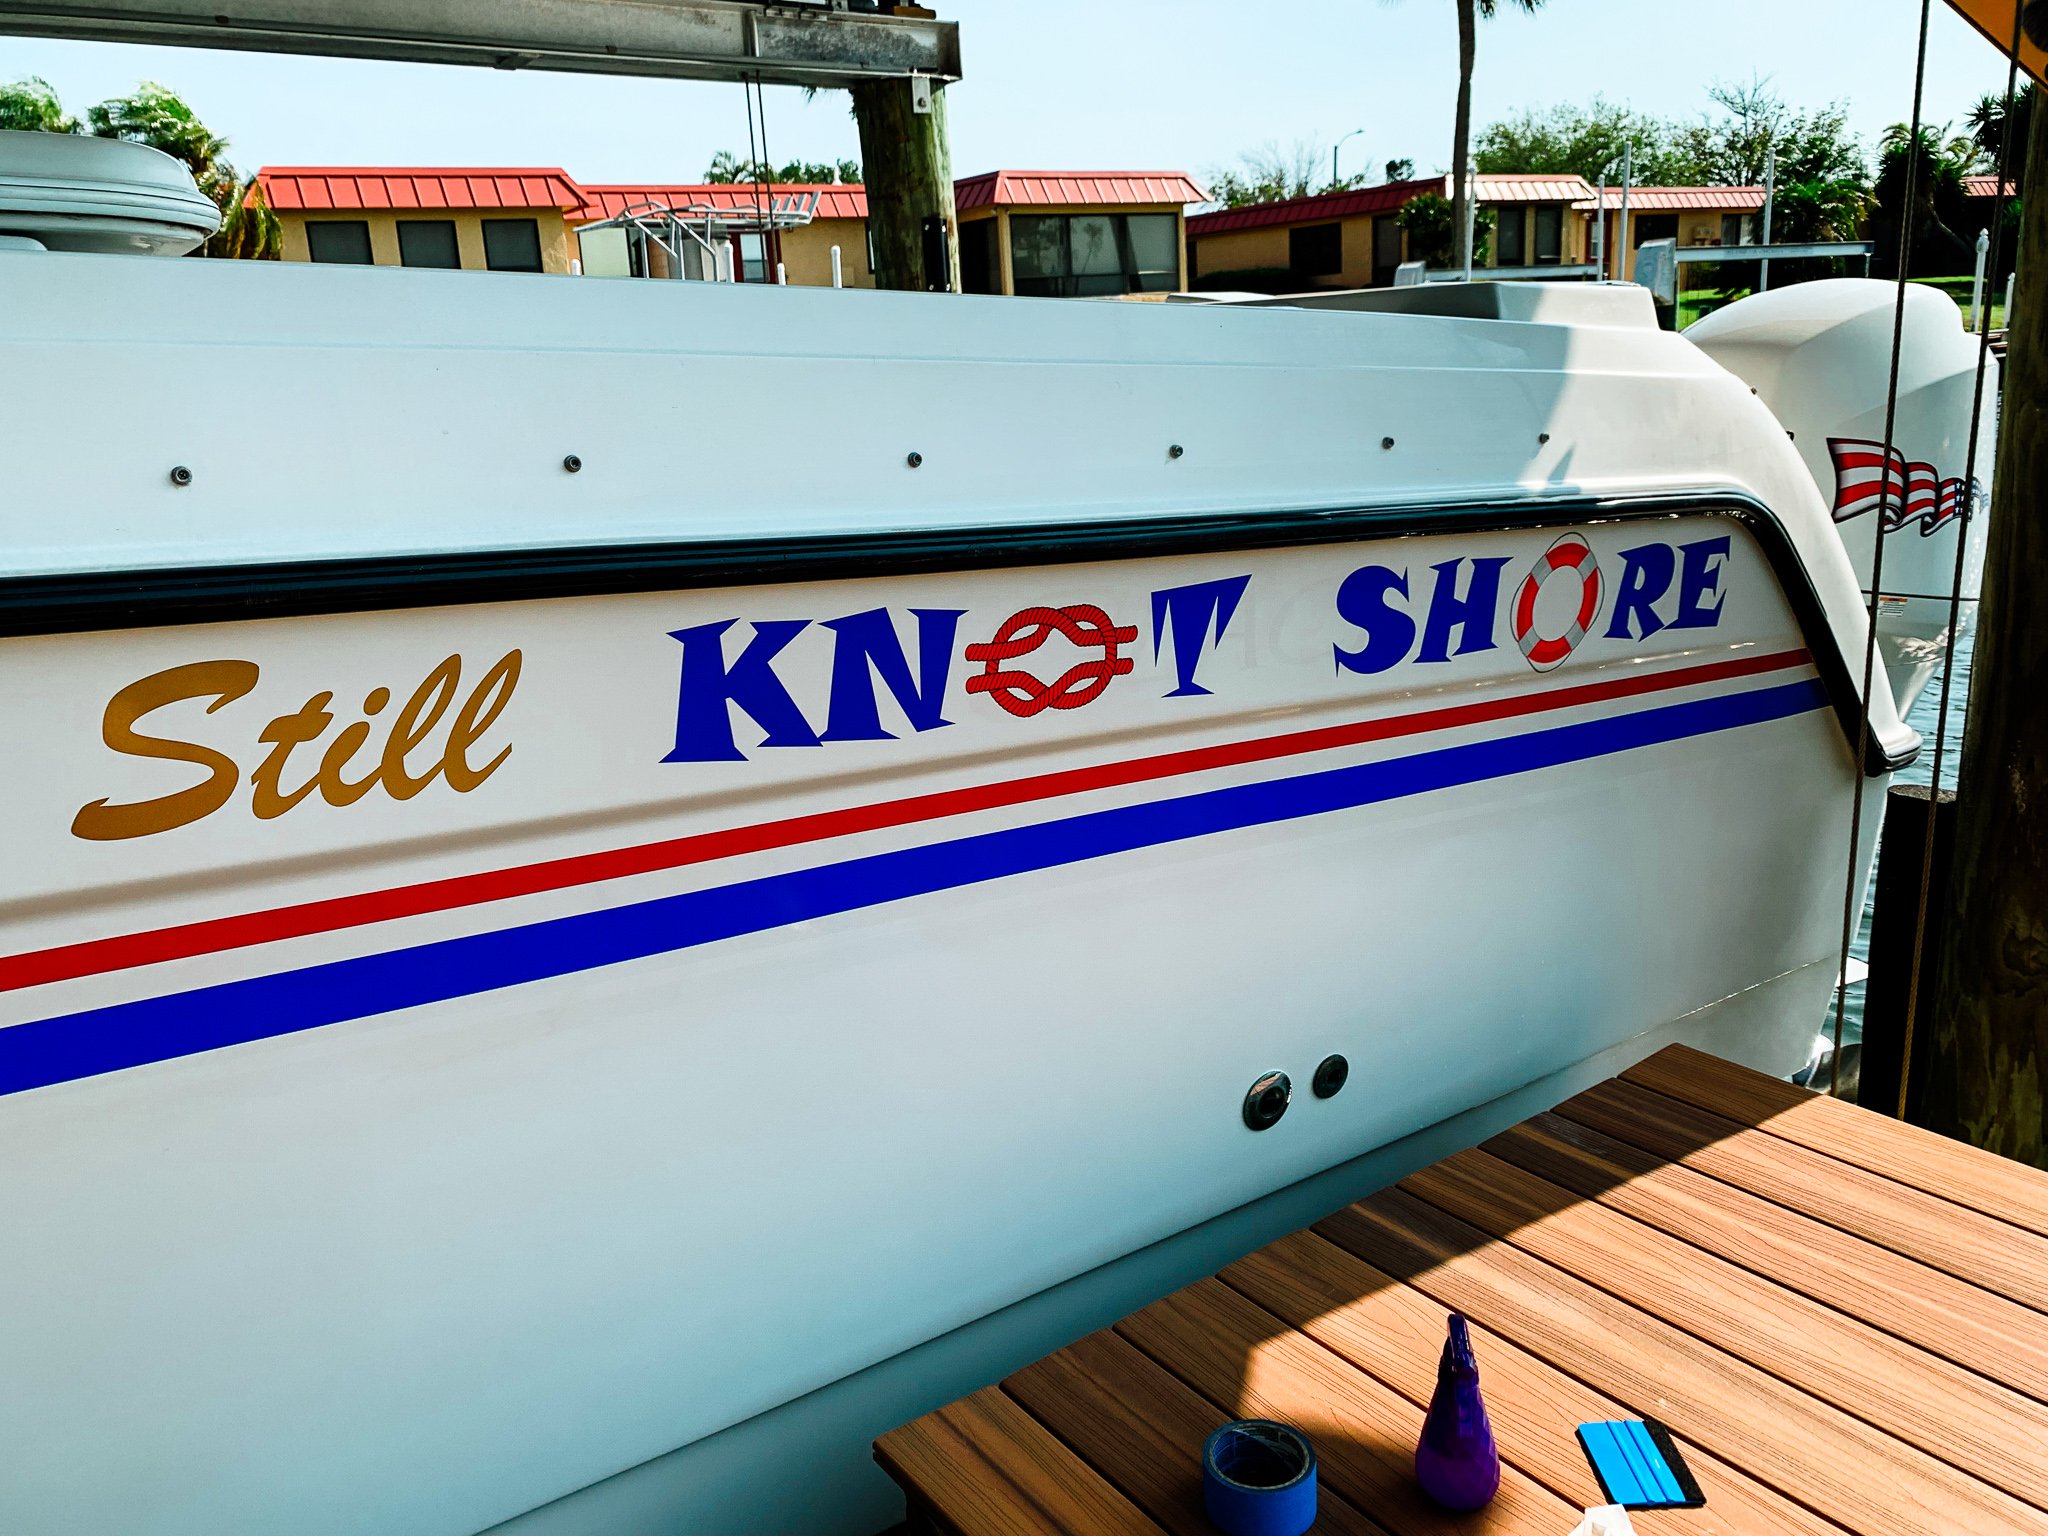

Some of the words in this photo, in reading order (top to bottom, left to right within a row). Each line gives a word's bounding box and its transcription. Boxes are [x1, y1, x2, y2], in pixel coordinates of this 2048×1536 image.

[71, 649, 522, 840] Still
[658, 574, 1252, 763] KNOT
[1334, 532, 1731, 676] SHORE
